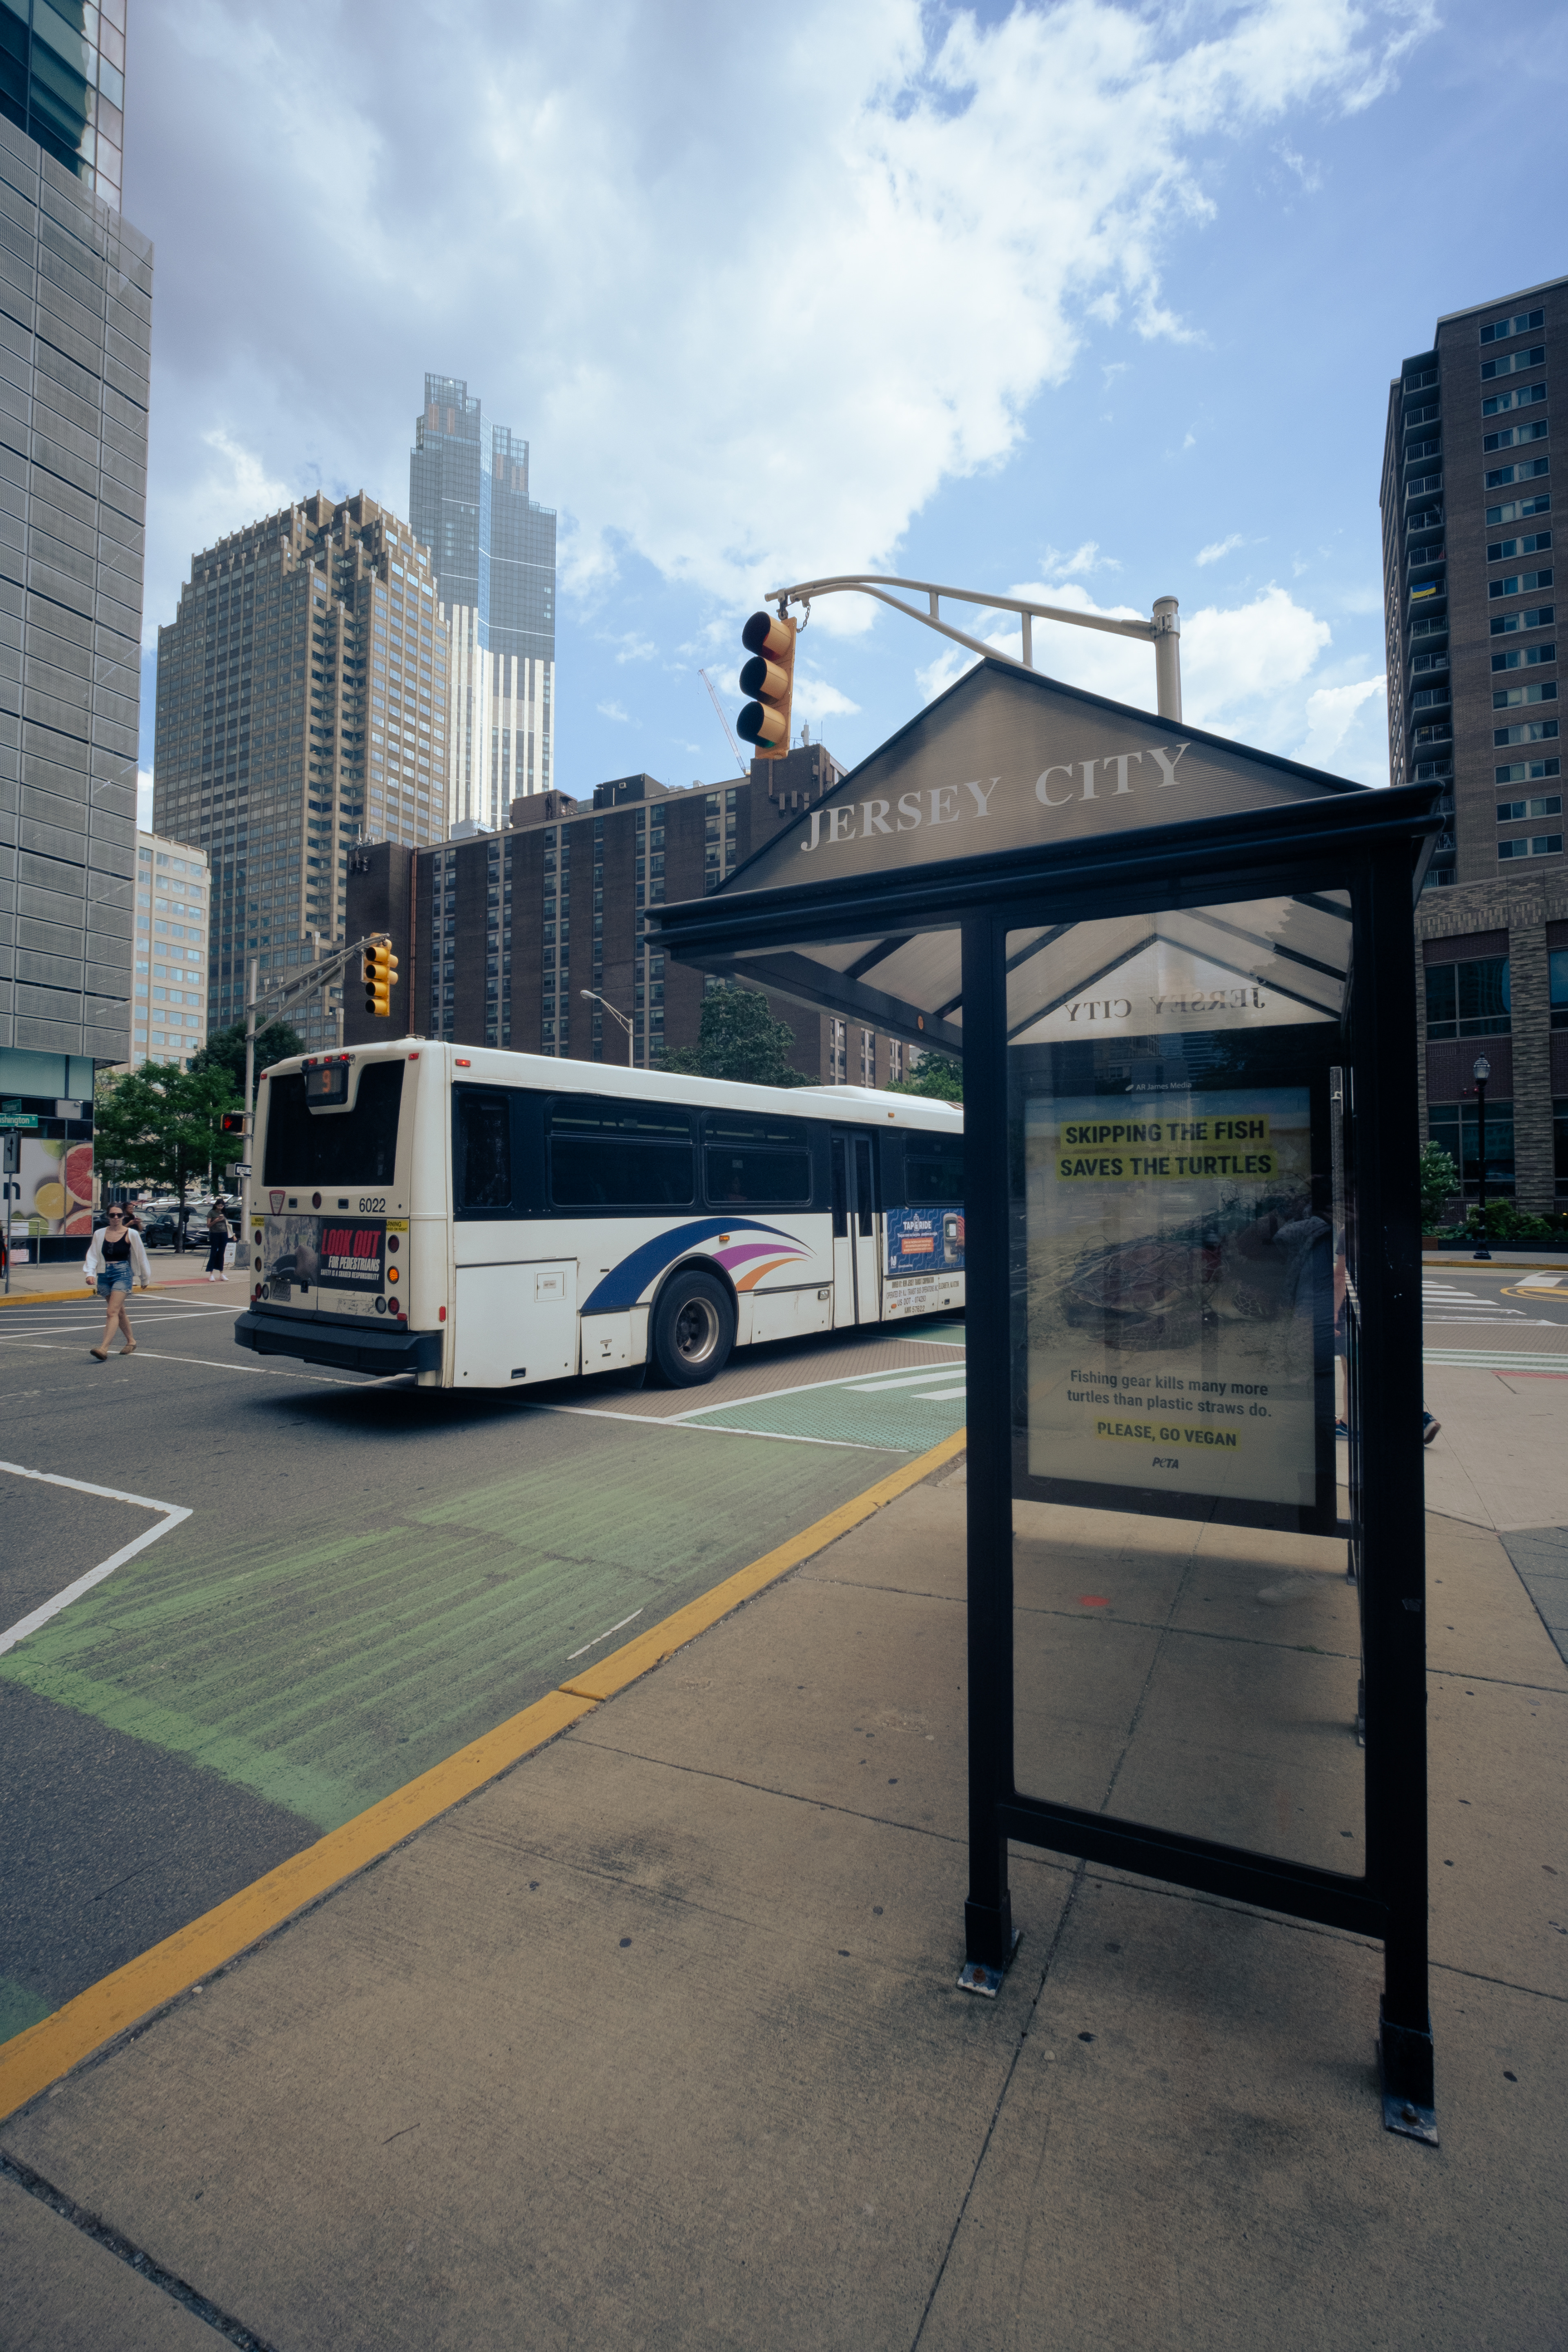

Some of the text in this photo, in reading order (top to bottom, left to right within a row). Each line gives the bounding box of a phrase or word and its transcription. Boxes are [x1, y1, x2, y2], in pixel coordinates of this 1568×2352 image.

[800, 742, 1191, 852] JERSEY CITY
[322, 1069, 331, 1093] 9
[1066, 1120, 1264, 1144] SKIPPING THE FISH
[1060, 1155, 1272, 1176] SAVES THE TURTLES
[359, 1198, 386, 1213] 6022
[903, 1221, 914, 1230] TAP
[919, 1221, 931, 1229] RIDE
[321, 1229, 381, 1258] LOOK OUT
[328, 1256, 380, 1272] FOR PEDESTRIANS
[351, 1272, 379, 1280] RESPONSIBILITY
[886, 1291, 898, 1299] OPERATED
[1070, 1370, 1268, 1396] Fishing gear kills many more
[1067, 1390, 1272, 1417] turtles than plastic straws do.
[1098, 1421, 1236, 1446] PLEASE, GO VEGAN
